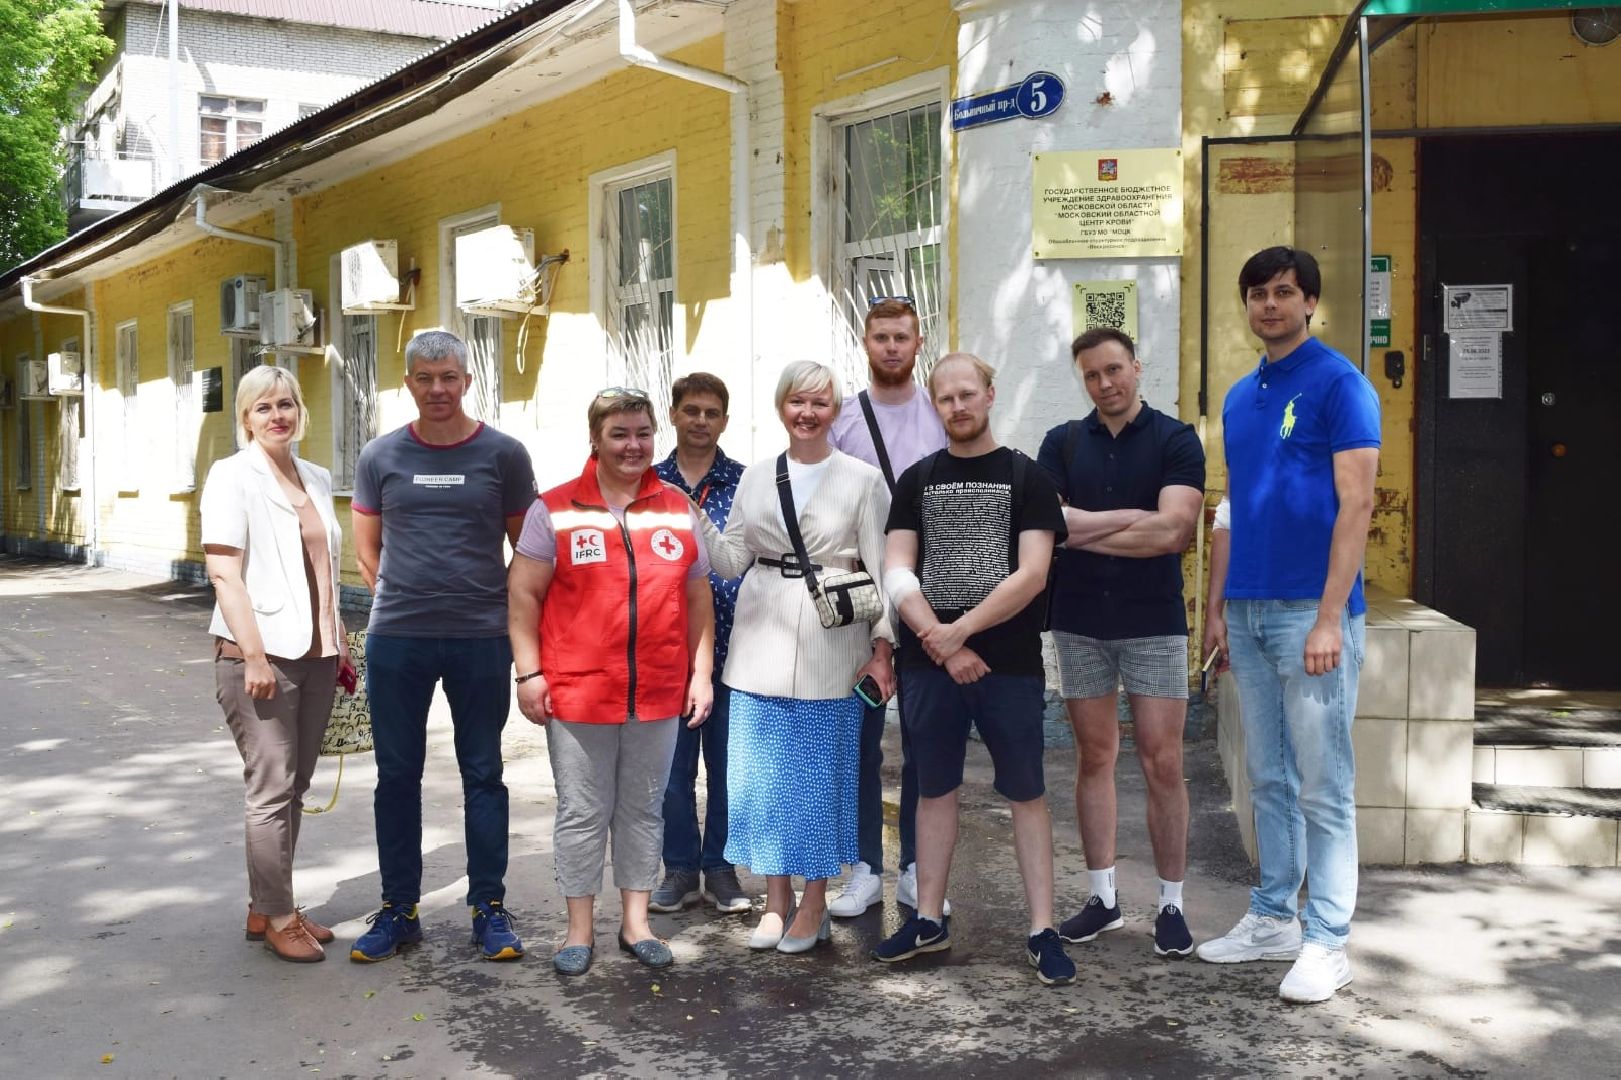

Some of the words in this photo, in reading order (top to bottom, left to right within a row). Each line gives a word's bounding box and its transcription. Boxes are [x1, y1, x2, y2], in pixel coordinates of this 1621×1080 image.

[1030, 80, 1047, 112] 5
[997, 98, 1016, 112] пр-д
[1044, 187, 1119, 195] ГОСУДАРСТВЕННОЕ
[1043, 195, 1095, 203] УЧРЕЖДЕНИЕ
[1096, 194, 1173, 202] ЗДРАВООХРАНЕНИЯ
[1113, 209, 1161, 217] ОБЛАСТНОЙ
[935, 482, 964, 490] СВОЁМ
[965, 482, 1011, 490] ПОЗНАНИИ
[575, 548, 601, 559] IFRC
